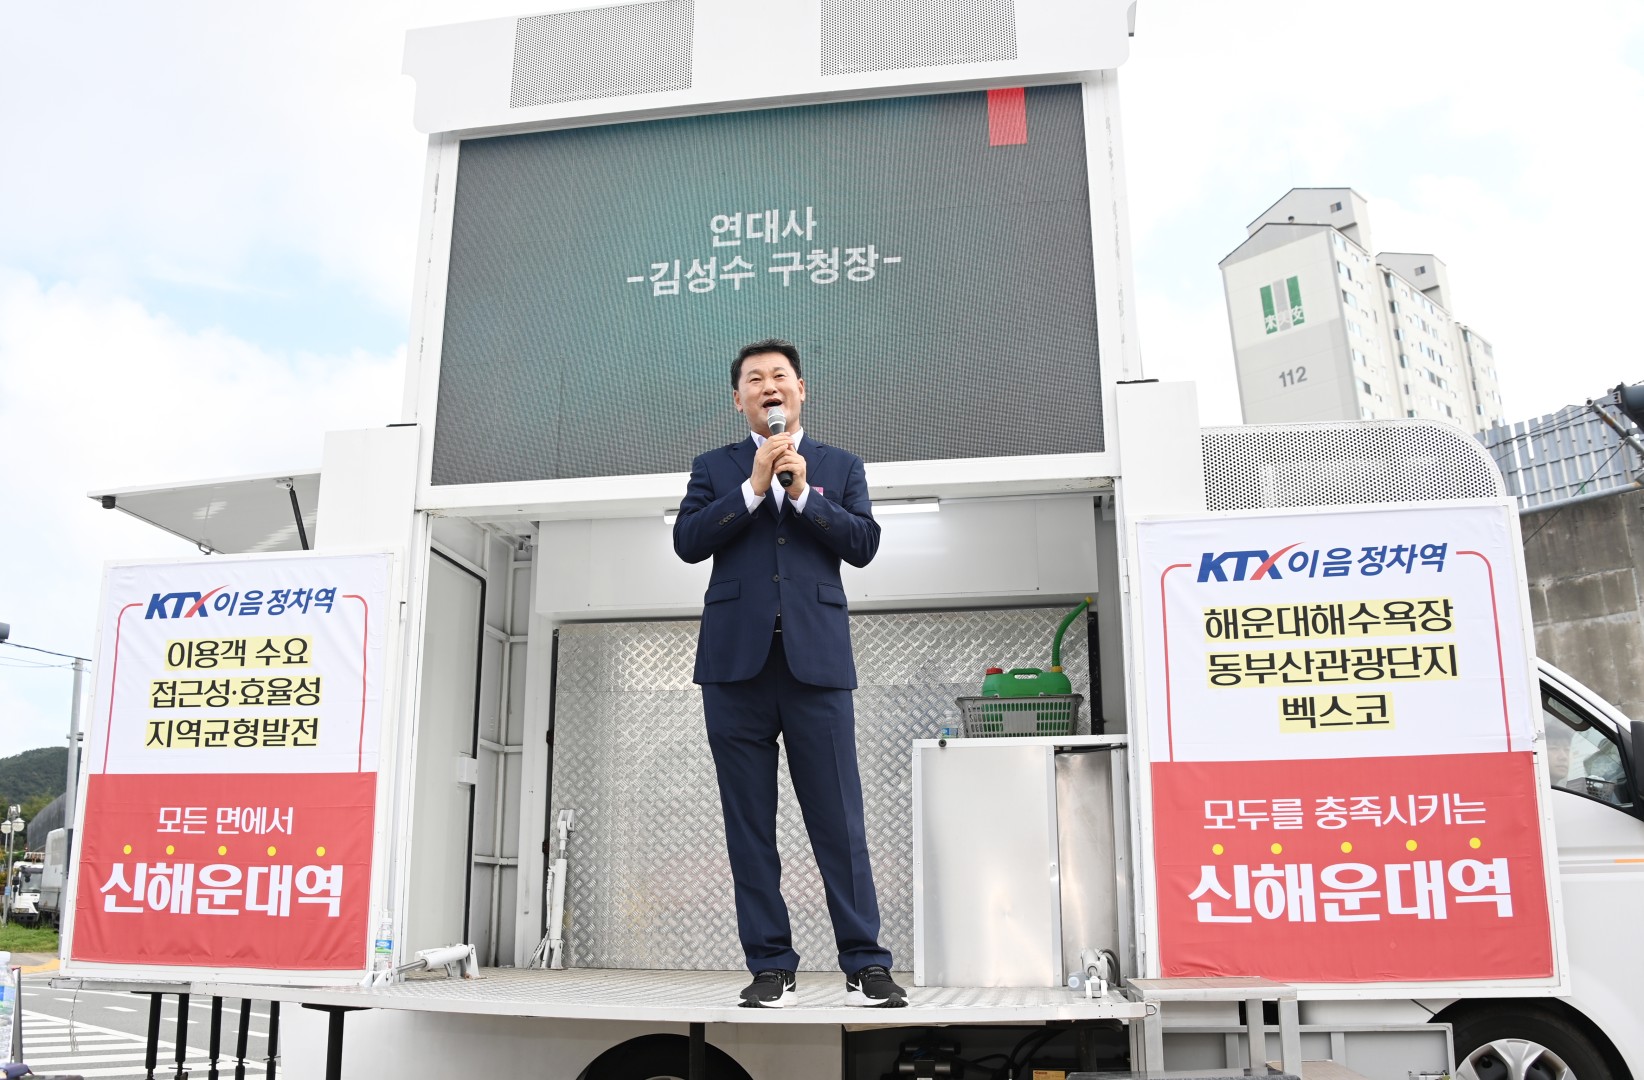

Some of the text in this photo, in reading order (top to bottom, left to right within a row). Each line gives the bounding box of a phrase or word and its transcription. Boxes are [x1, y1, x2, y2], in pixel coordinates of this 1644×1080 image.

[710, 206, 817, 247] 연대사
[1278, 366, 1308, 388] 112
[1356, 542, 1448, 577] 정차역
[266, 586, 338, 616] 정차역
[1204, 599, 1454, 640] 해운대해수욕장
[167, 637, 308, 669] 이용객 수요
[1208, 644, 1458, 686] 동부산관광단지
[1282, 694, 1390, 729] 벡스코
[146, 717, 318, 748] 지역균형발전
[156, 806, 294, 835] 모든 면에서
[1203, 793, 1486, 831] 모두를 충족시키는
[99, 862, 344, 918] 신해운대역
[1188, 857, 1514, 924] 신해운대역
